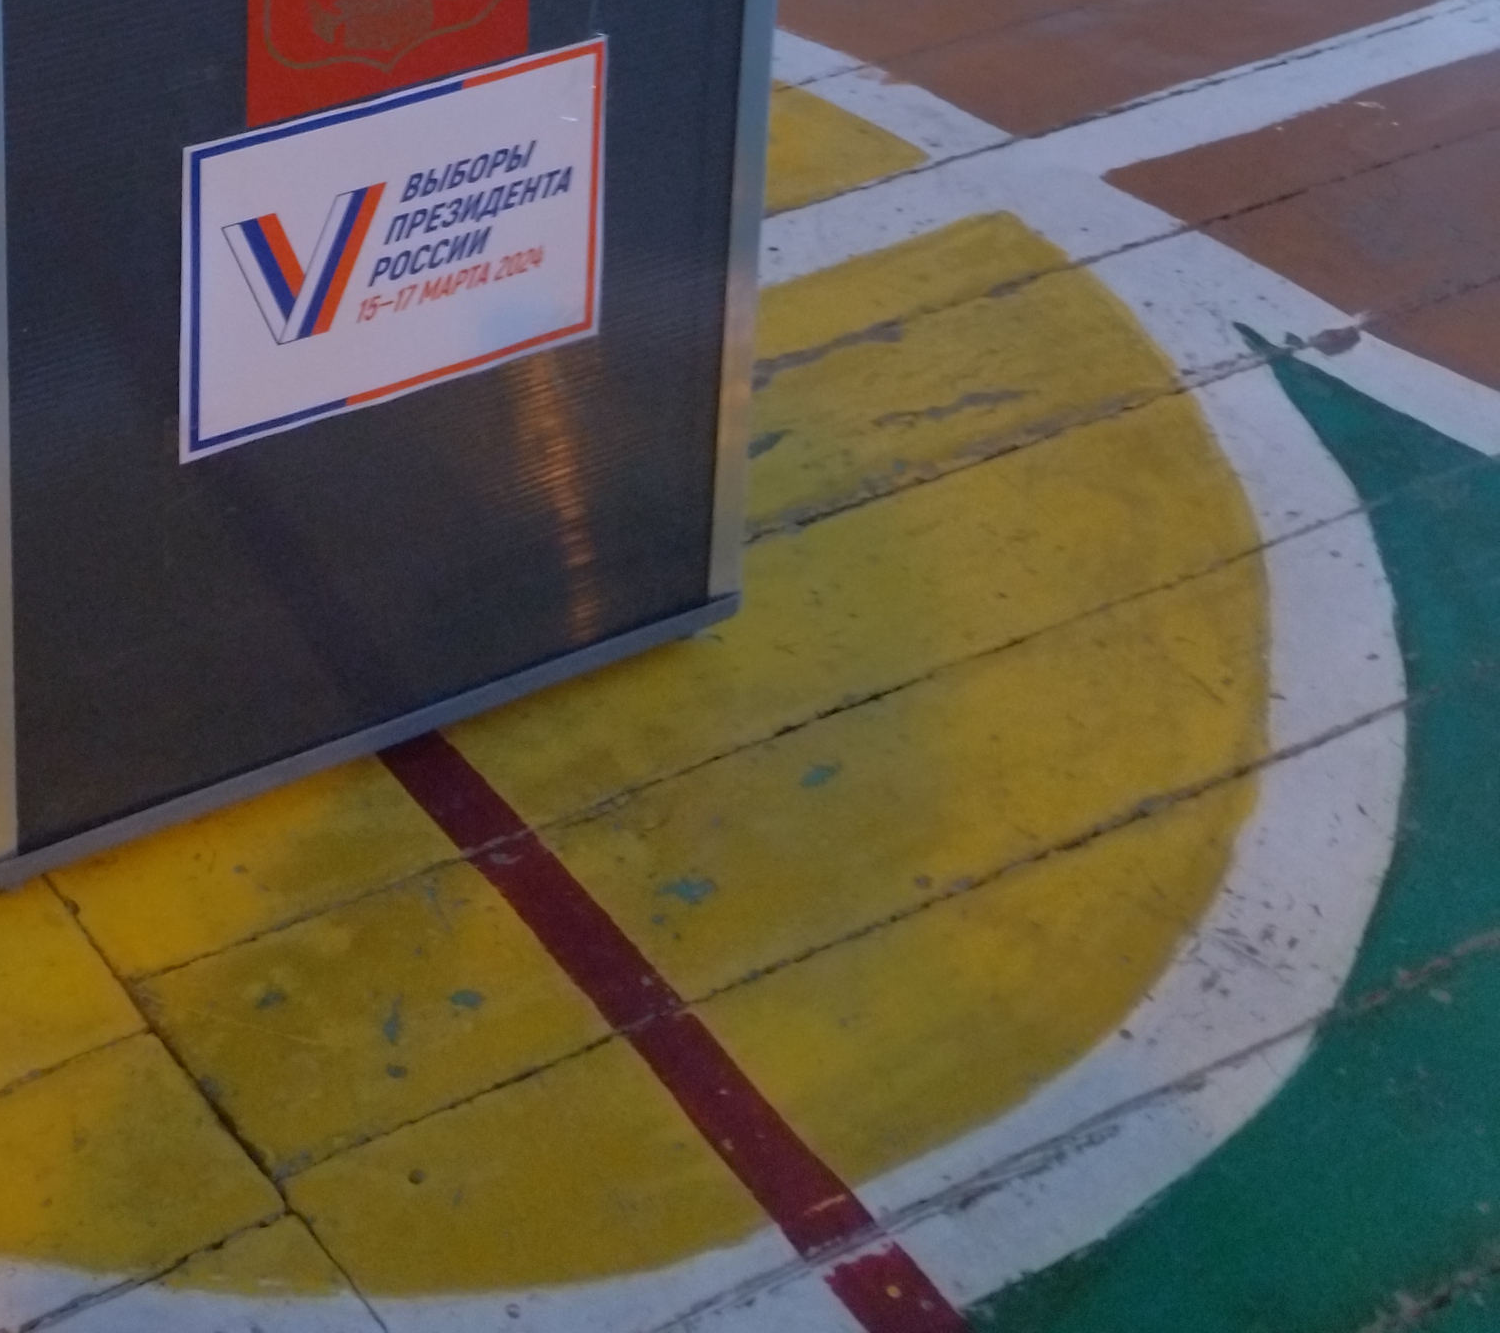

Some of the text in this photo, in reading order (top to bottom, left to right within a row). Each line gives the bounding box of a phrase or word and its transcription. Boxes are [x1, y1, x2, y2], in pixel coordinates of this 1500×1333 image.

[400, 140, 537, 203] ВЫБОРЫ
[384, 166, 573, 245] ПРЕЗИДЕНТА
[367, 226, 493, 287] РОССИИ
[419, 261, 491, 304] МАРТА
[494, 246, 544, 281] 2024
